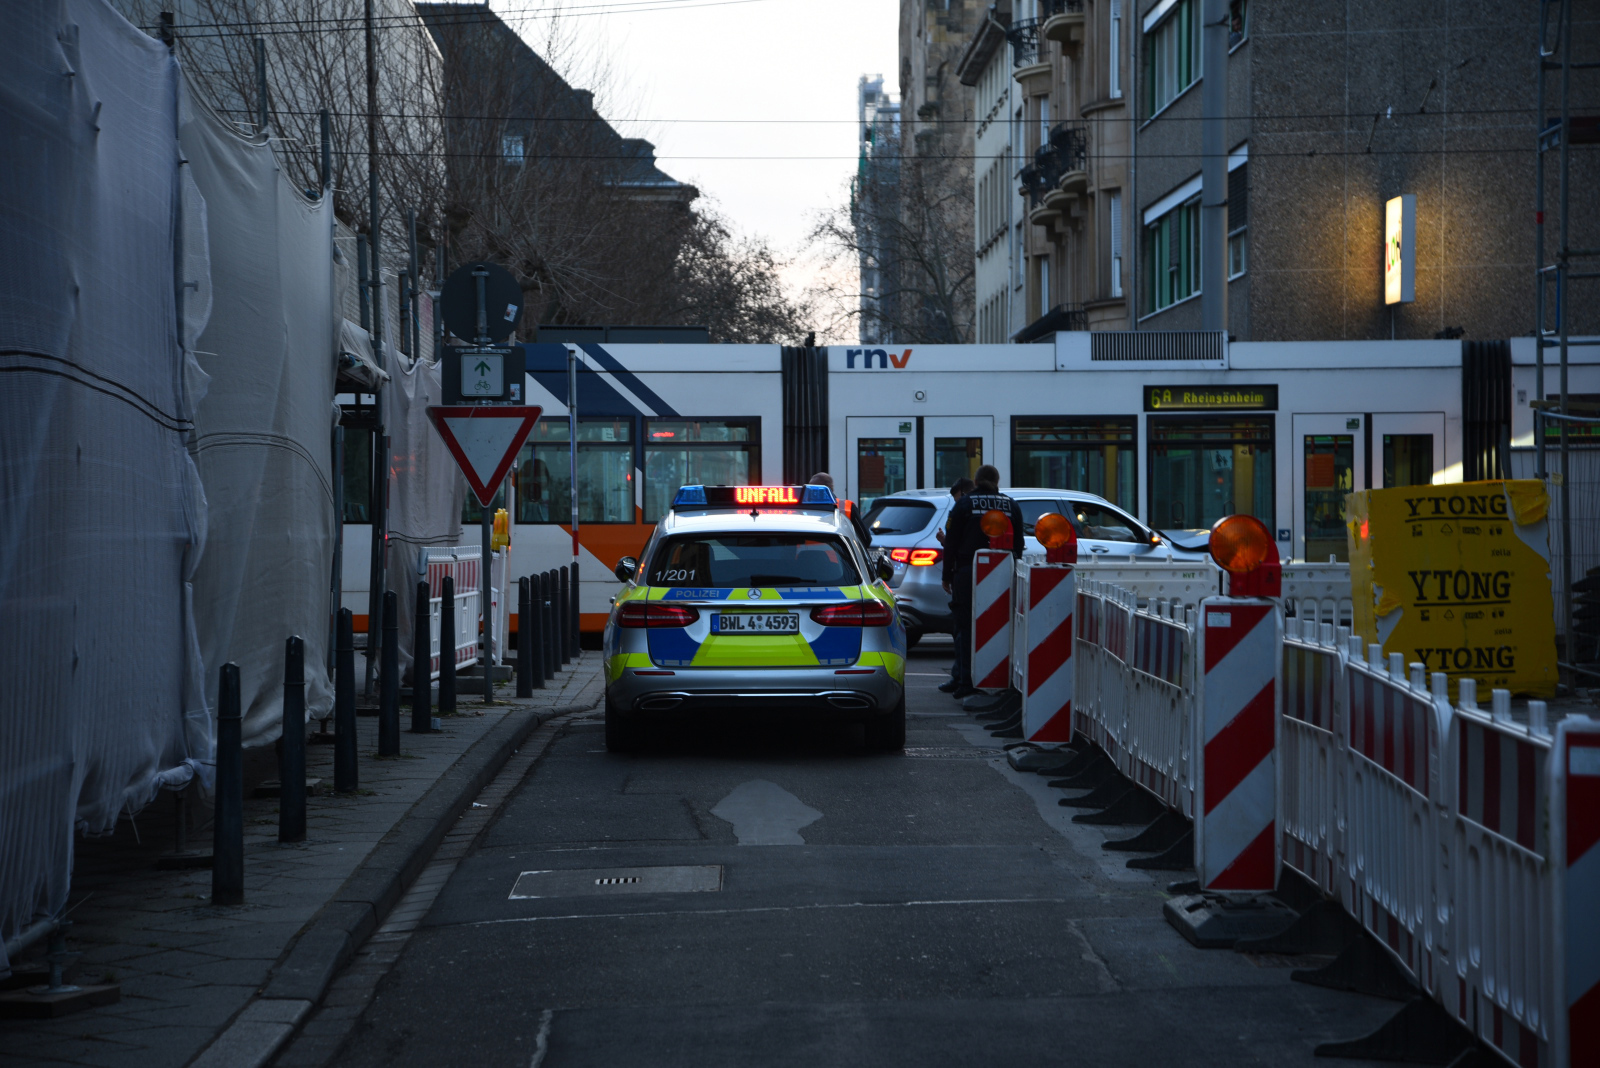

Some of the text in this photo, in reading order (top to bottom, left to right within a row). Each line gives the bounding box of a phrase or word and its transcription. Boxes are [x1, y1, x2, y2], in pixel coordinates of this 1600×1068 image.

[846, 348, 913, 369] rnv
[1183, 391, 1264, 404] Rheingönheim
[736, 487, 799, 503] UNFALL
[971, 498, 1012, 511] POLIZEI
[1404, 494, 1508, 517] YTONG
[655, 569, 696, 582] 1/201
[1408, 570, 1511, 601] YTONG
[675, 589, 720, 598] POLIZEI
[719, 616, 745, 630] BWL
[765, 615, 797, 630] 4593
[1414, 645, 1515, 670] YTONG
